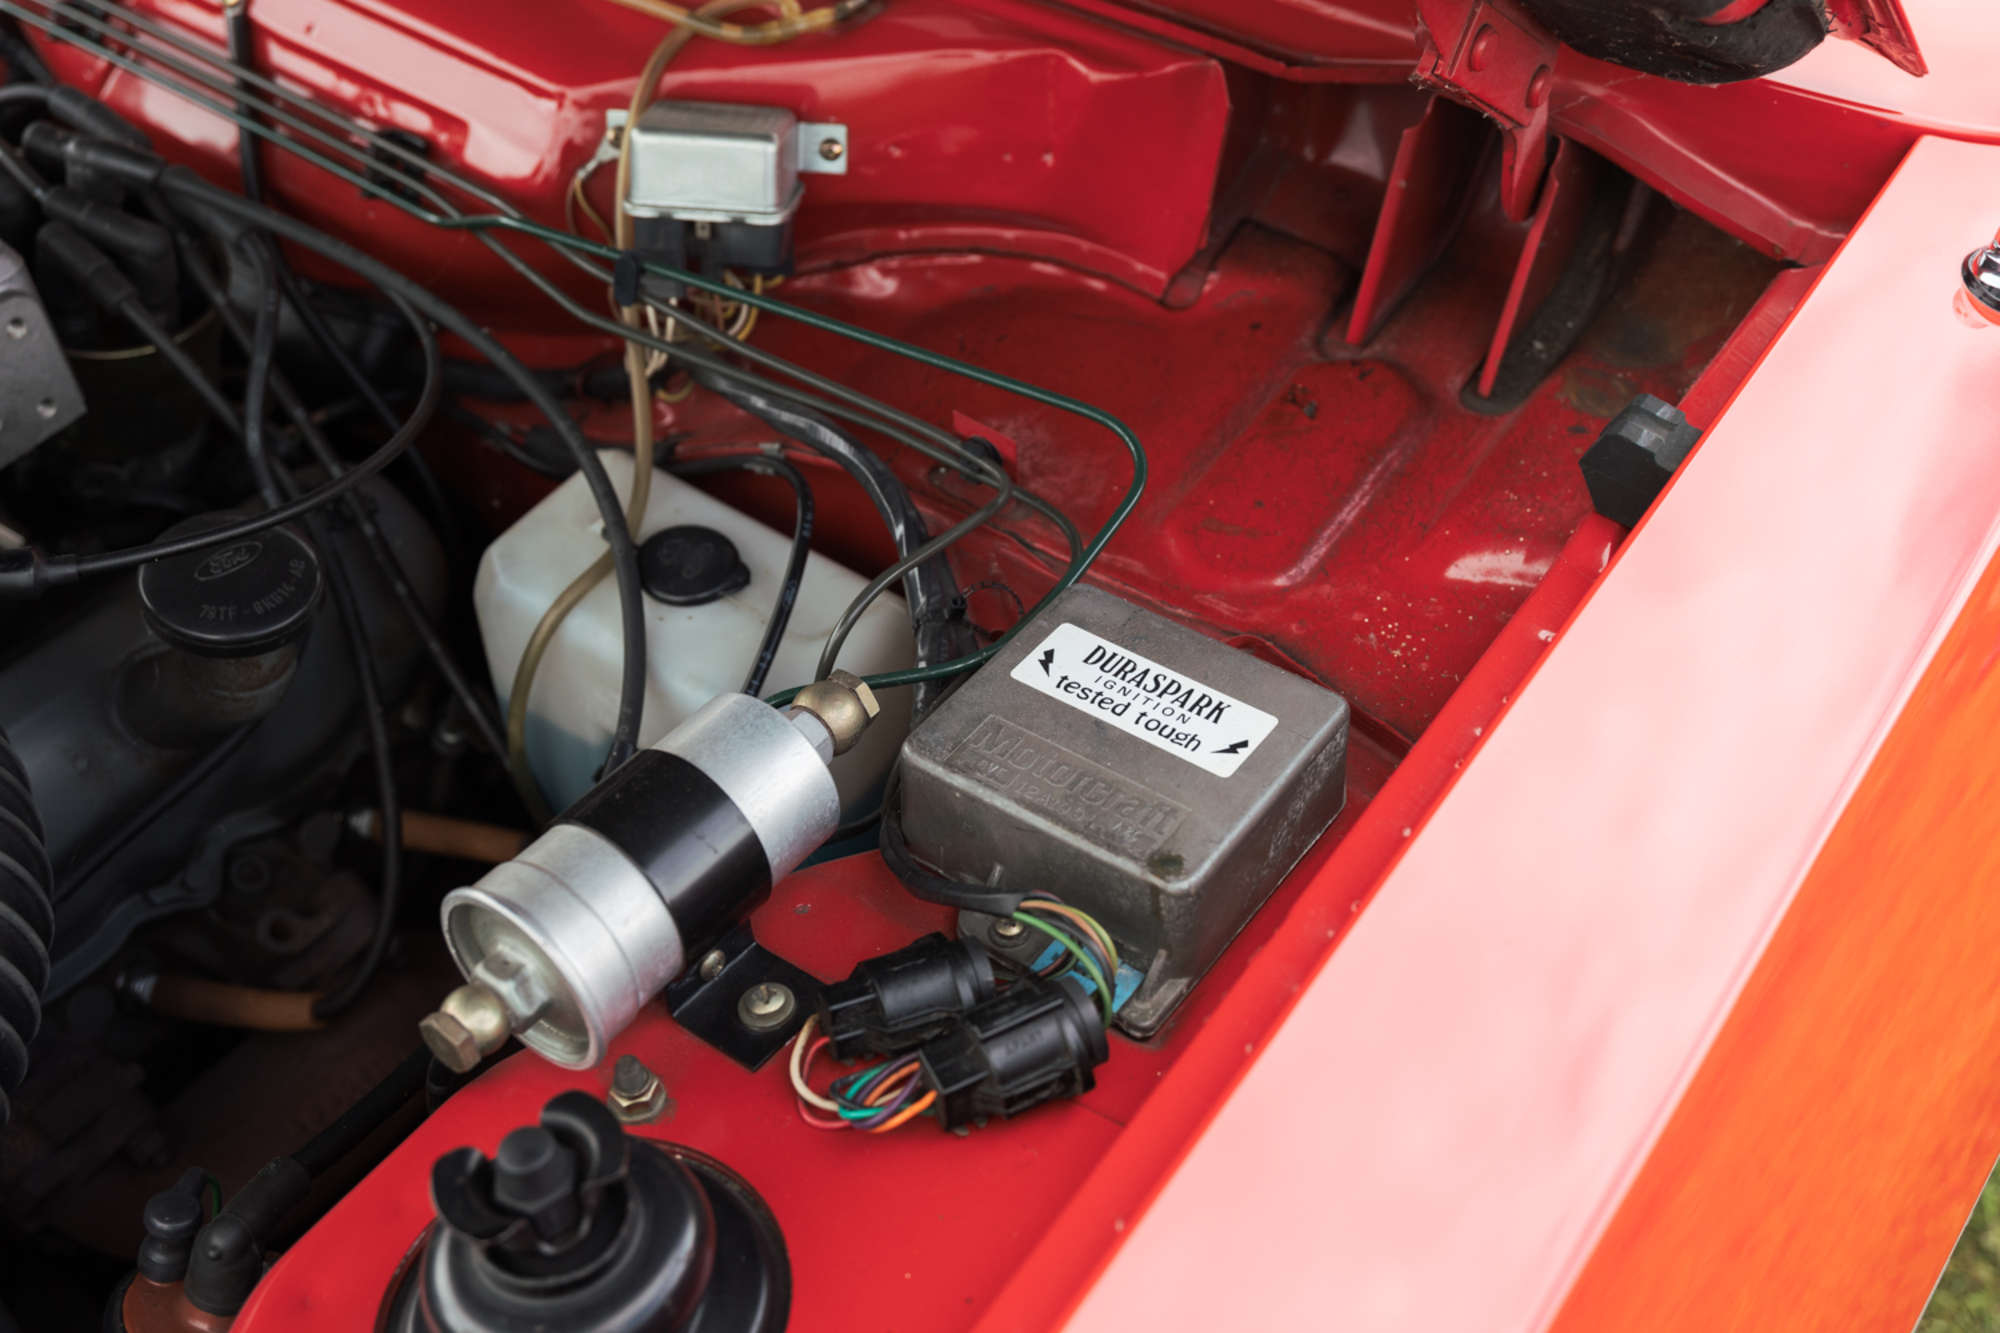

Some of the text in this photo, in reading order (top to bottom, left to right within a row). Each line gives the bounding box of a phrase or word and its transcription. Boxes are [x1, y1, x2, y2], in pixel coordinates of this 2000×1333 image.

[1056, 675, 1202, 752] tested tough
[1083, 645, 1232, 724] DURASPARK
[1094, 675, 1192, 724] IGNITION
